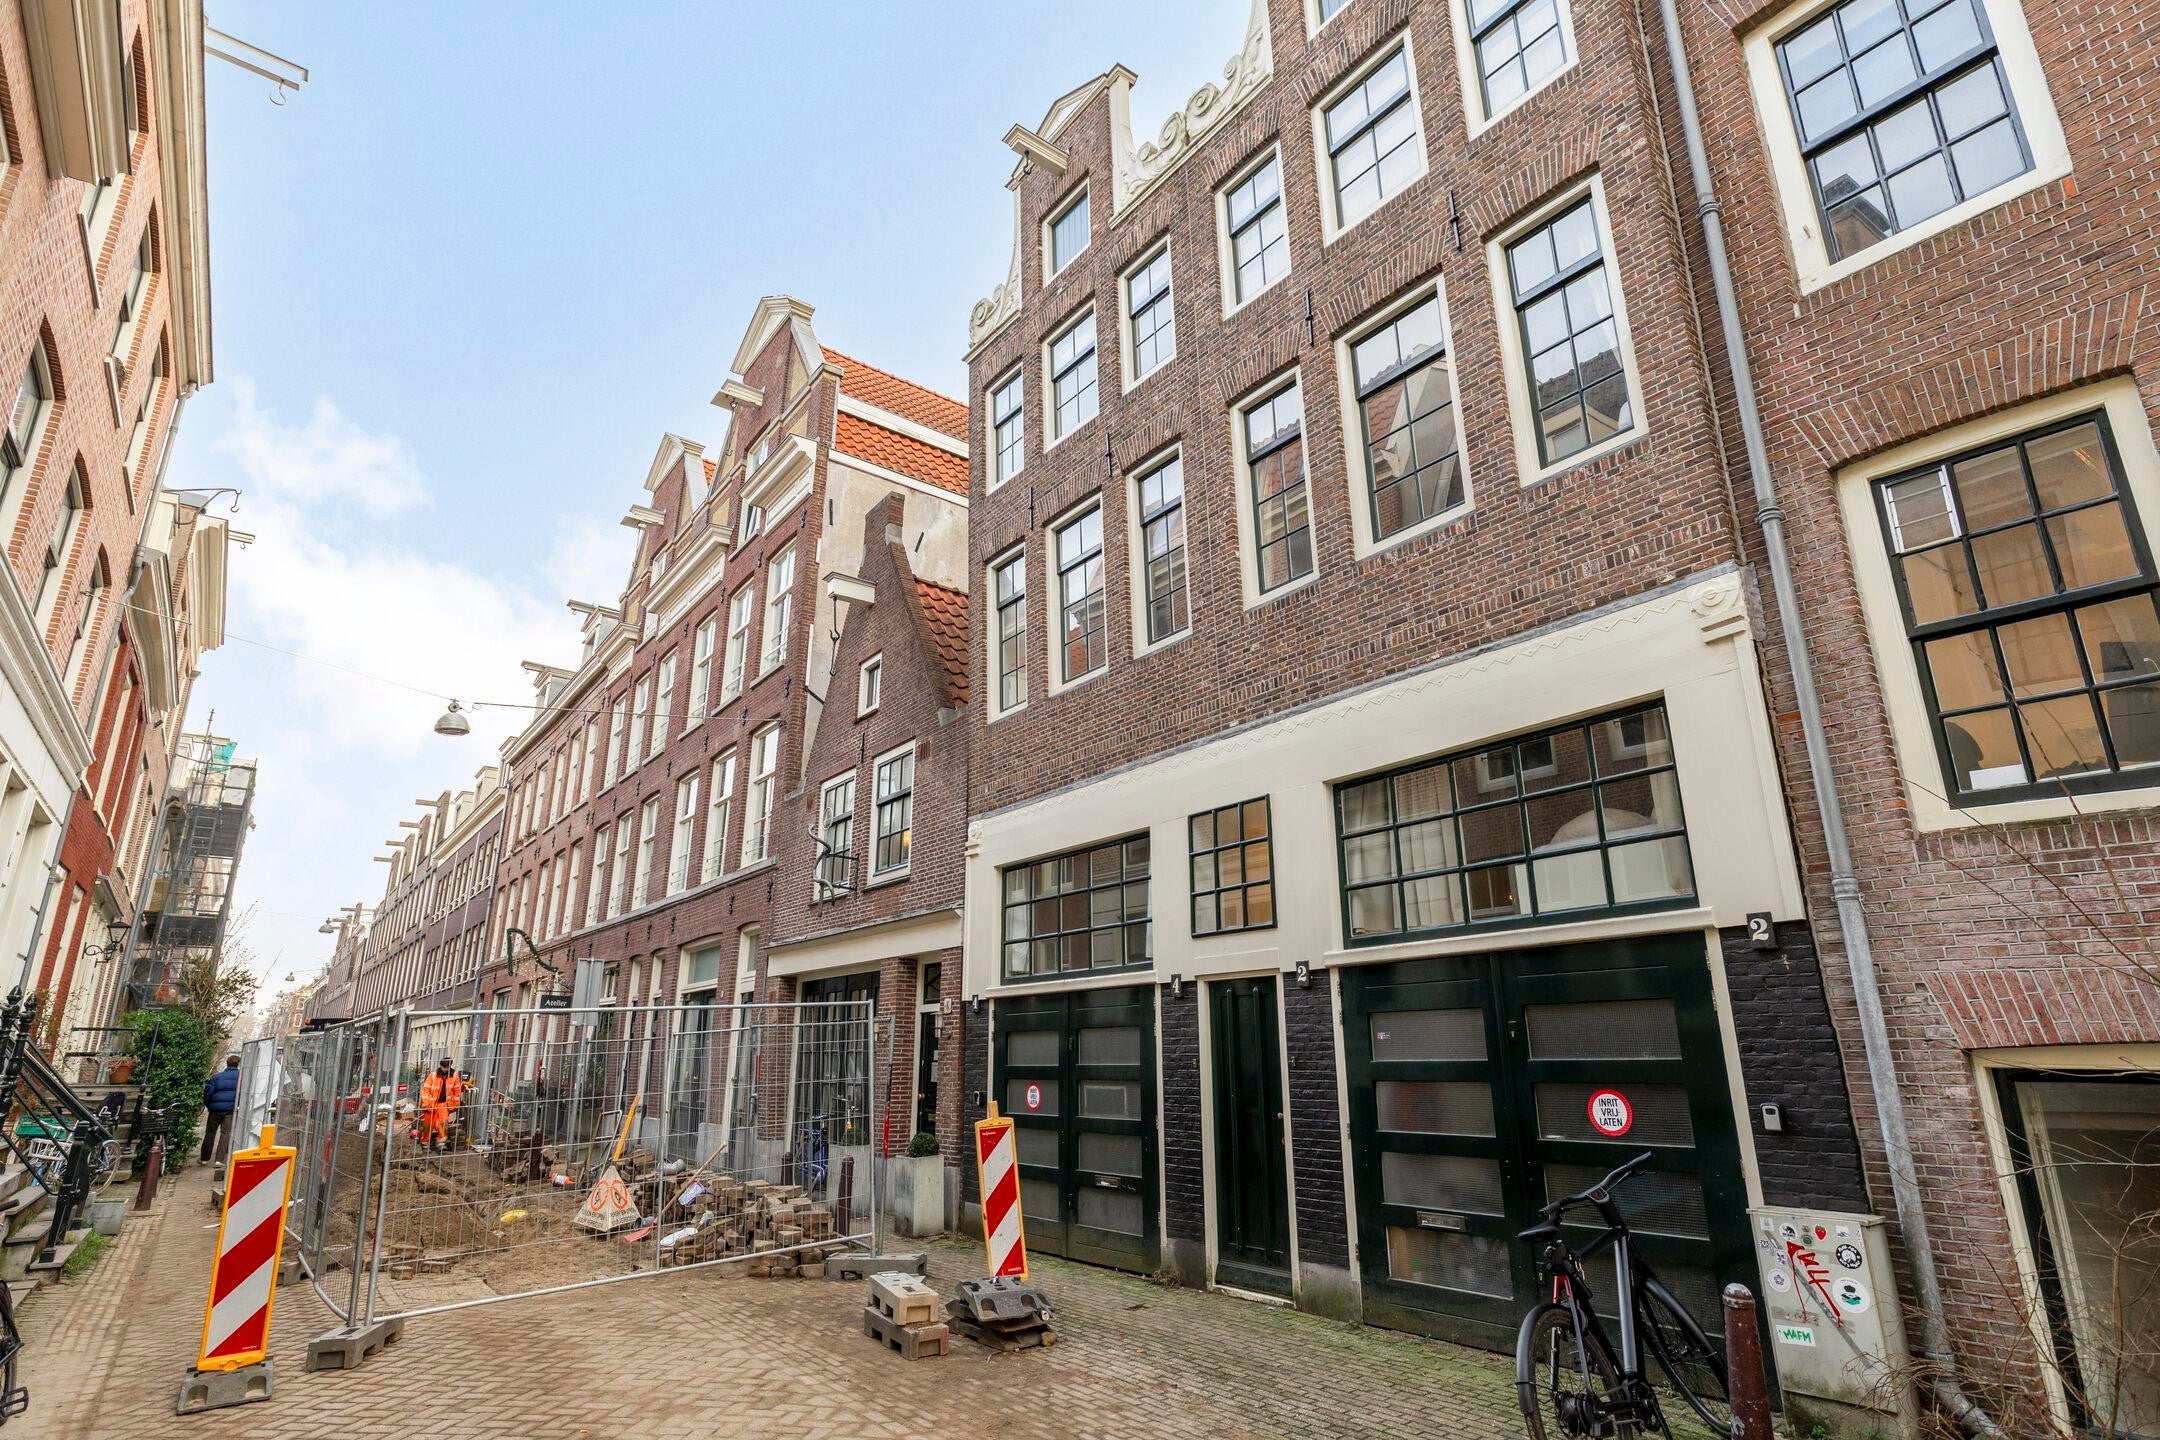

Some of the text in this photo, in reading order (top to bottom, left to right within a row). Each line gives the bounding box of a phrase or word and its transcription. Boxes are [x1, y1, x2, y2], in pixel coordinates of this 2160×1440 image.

[1750, 918, 1769, 941] 2
[1297, 965, 1307, 982] 2
[1172, 977, 1180, 993] 4
[544, 999, 568, 1007] Atelier
[1598, 1098, 1618, 1107] INRIT
[1599, 1117, 1623, 1127] LATEN
